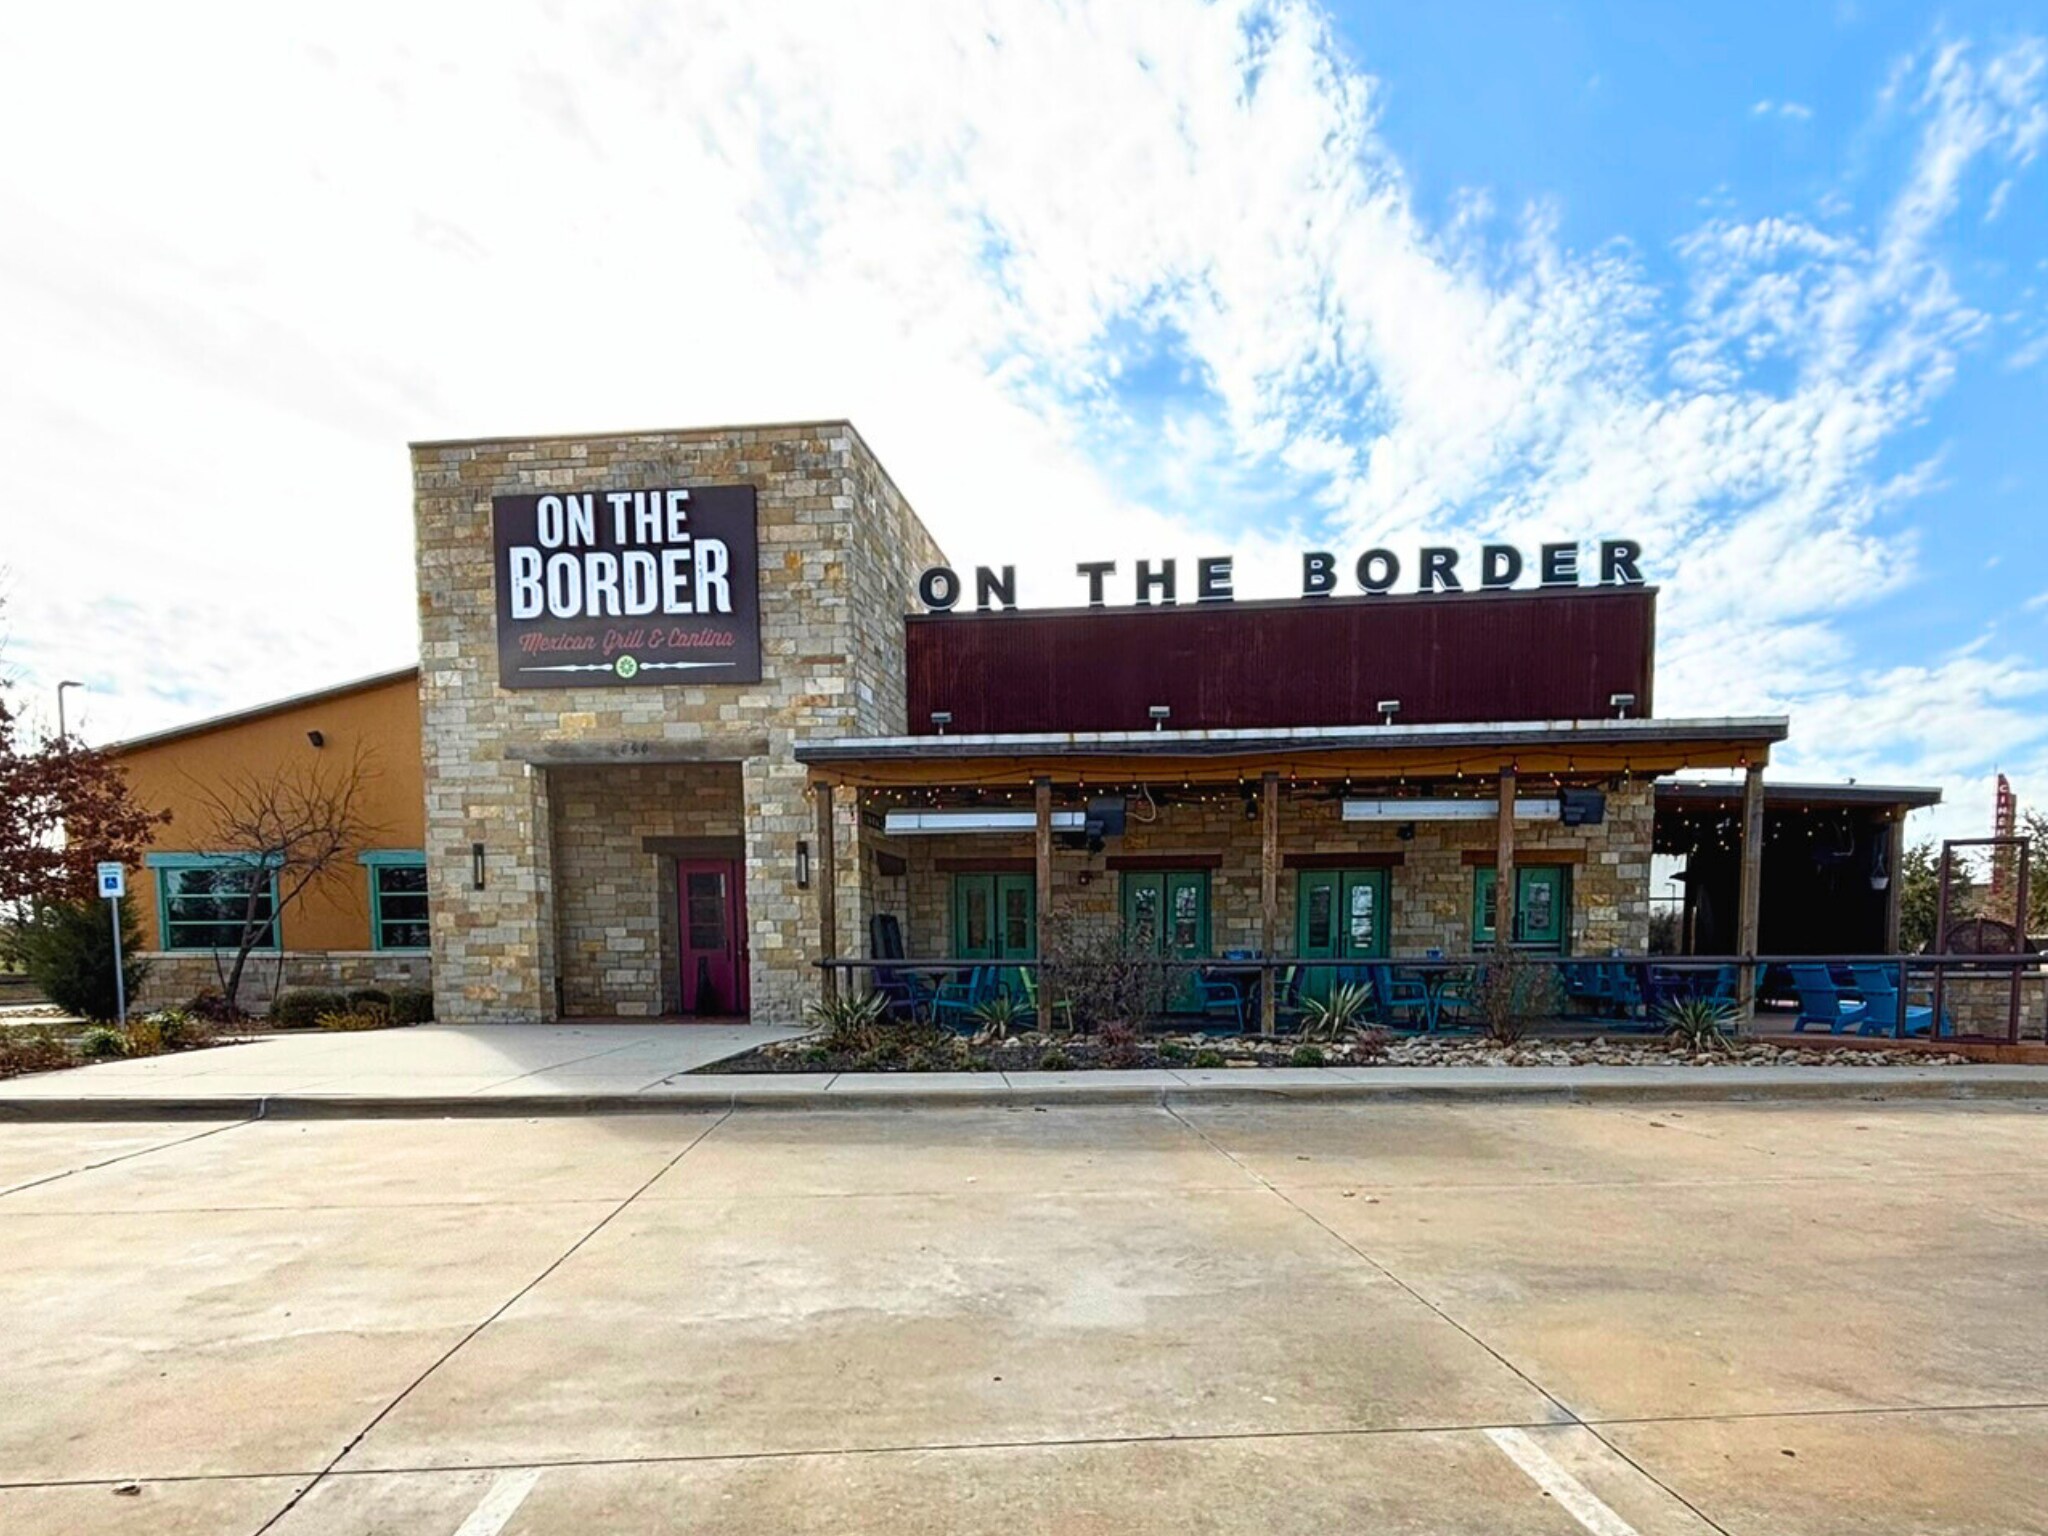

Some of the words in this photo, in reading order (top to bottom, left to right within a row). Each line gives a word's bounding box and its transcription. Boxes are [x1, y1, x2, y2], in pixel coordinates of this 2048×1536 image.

[537, 493, 595, 548] ON
[606, 490, 690, 545] THE
[509, 538, 732, 619] BORDER
[918, 564, 1017, 611] ON
[1076, 555, 1235, 606] THE
[1301, 539, 1646, 596] BORDER
[518, 631, 597, 656] Mexican
[602, 628, 644, 655] Grill
[648, 628, 665, 648] &
[668, 627, 736, 648] Cantina
